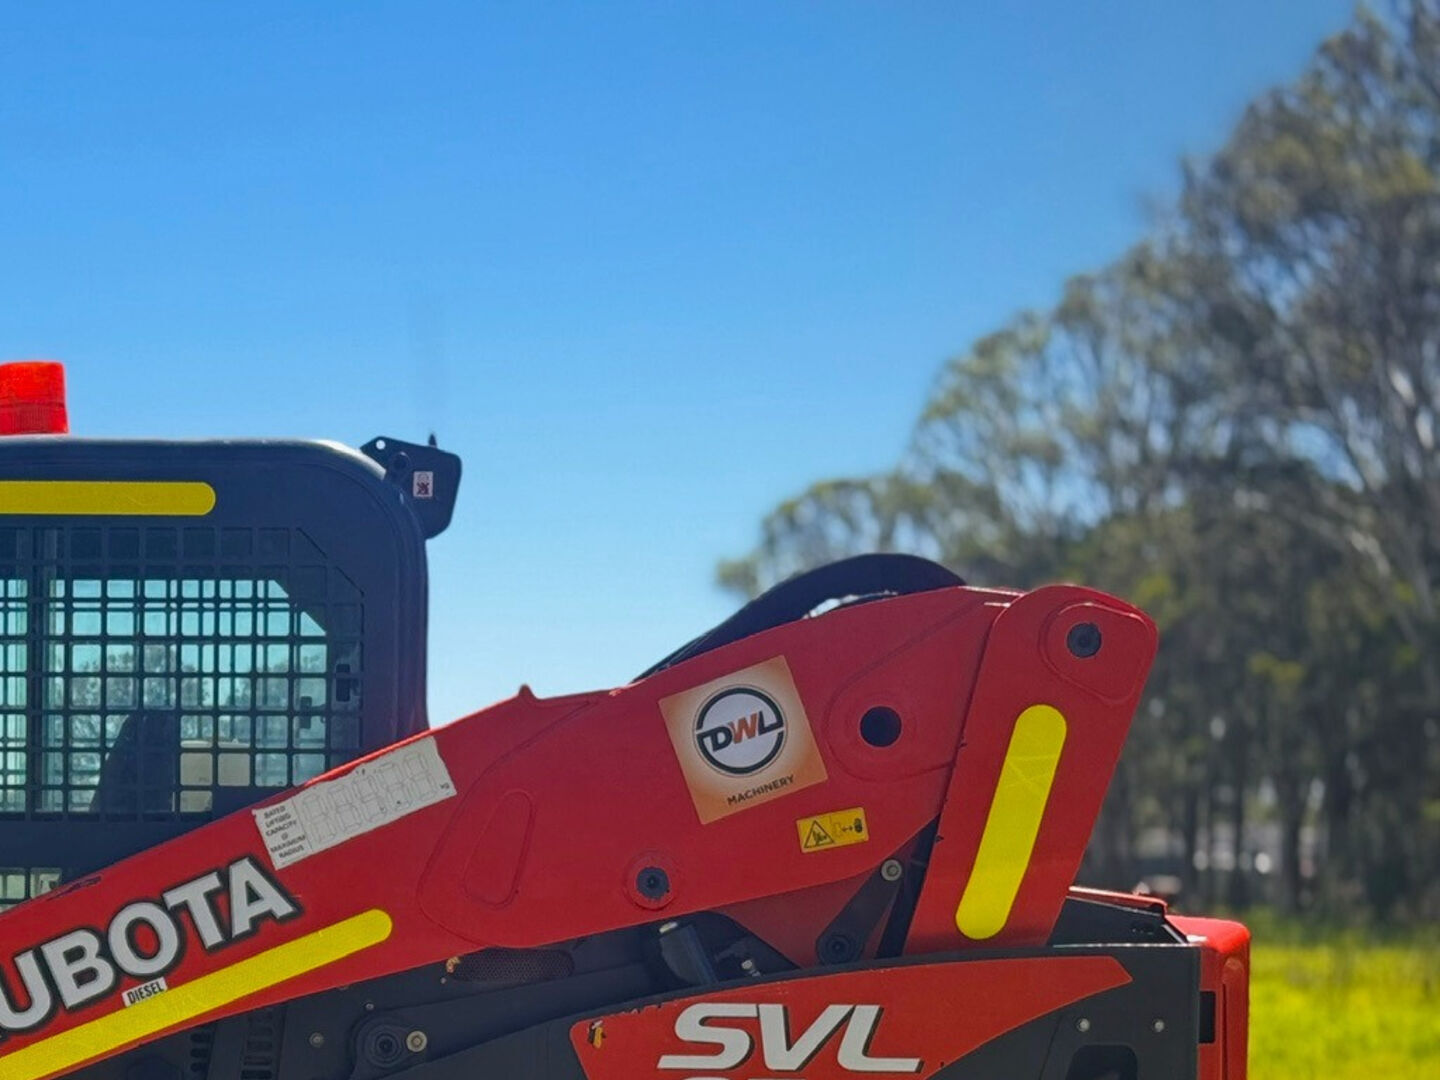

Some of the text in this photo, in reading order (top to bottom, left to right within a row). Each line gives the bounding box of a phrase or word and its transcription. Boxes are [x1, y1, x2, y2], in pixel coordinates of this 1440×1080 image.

[697, 710, 785, 752] DWL
[727, 774, 795, 806] MACHINERY
[126, 980, 165, 1005] DIESEL
[657, 1002, 924, 1073] SVL
